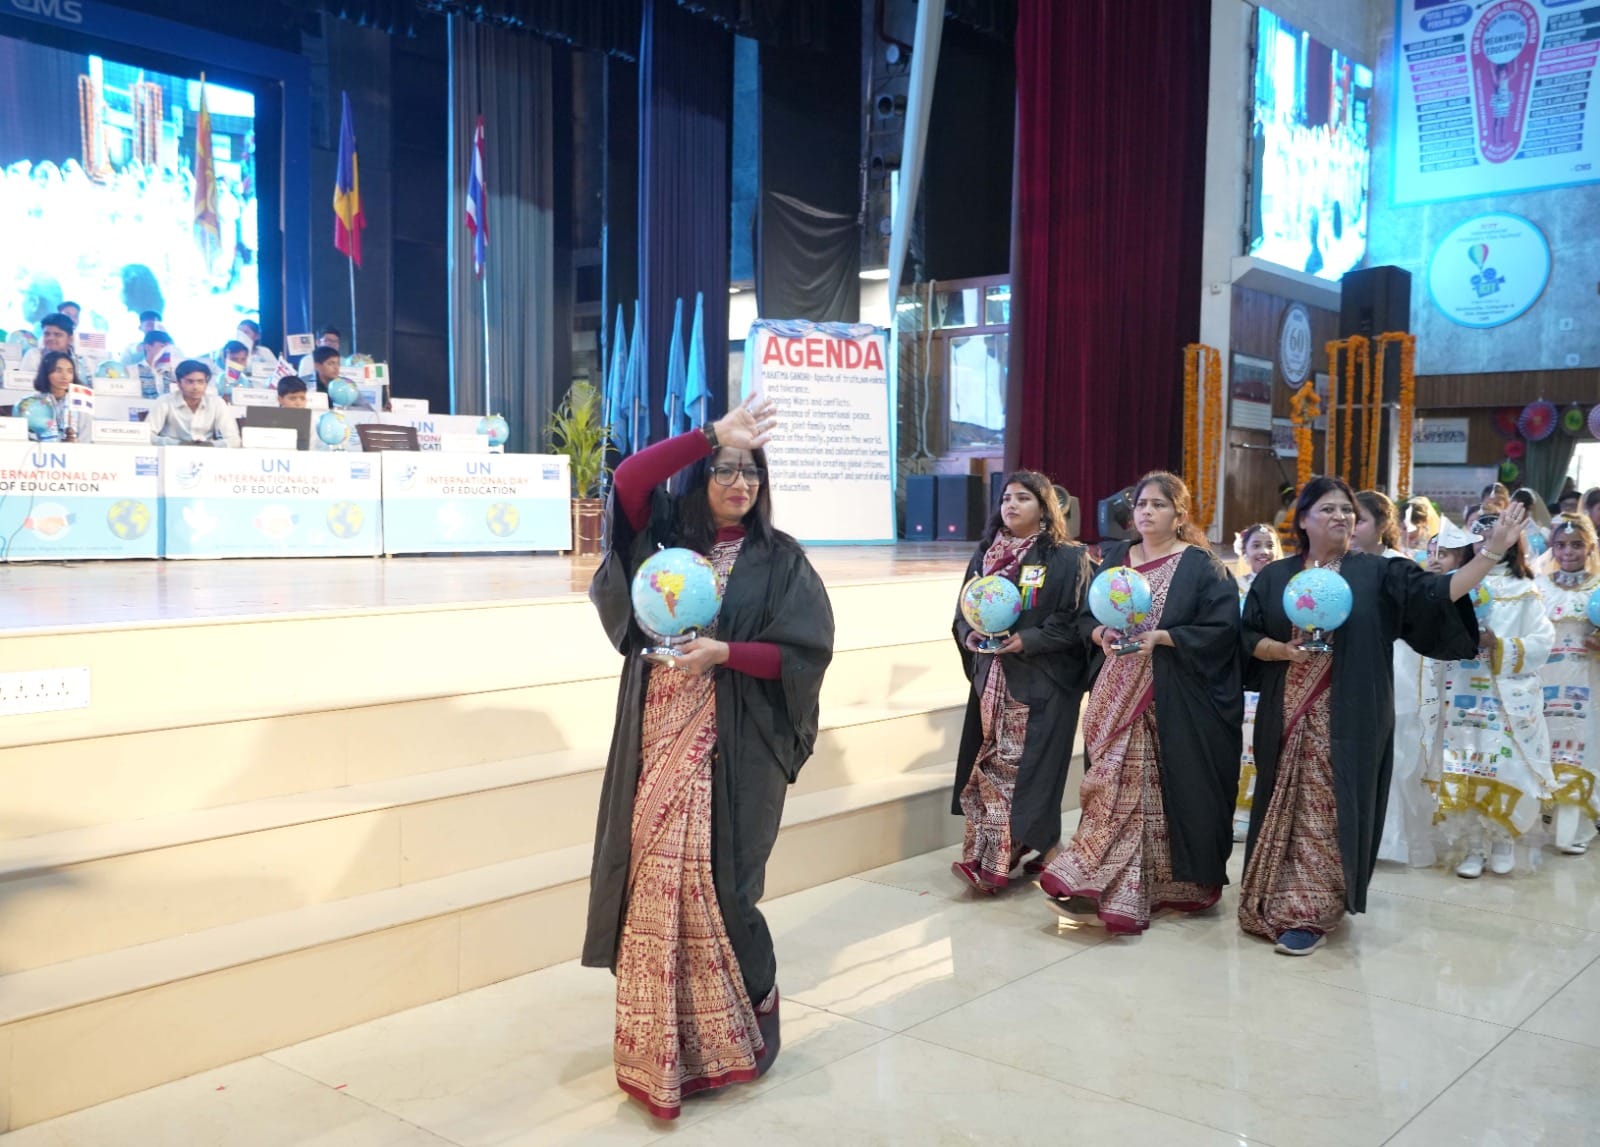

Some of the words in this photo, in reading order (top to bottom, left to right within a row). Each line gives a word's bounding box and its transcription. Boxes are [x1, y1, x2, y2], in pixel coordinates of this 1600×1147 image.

[1484, 32, 1525, 44] MEANINGFUL
[1486, 42, 1522, 56] EDUCATION
[762, 336, 884, 370] AGENDA
[811, 398, 821, 406] and
[804, 409, 810, 417] of
[812, 410, 850, 419] international
[852, 412, 872, 422] peace.
[807, 422, 826, 432] family
[863, 436, 882, 444] world.
[768, 446, 784, 456] Open
[785, 446, 824, 454] communication
[32, 453, 66, 468] UN
[262, 459, 290, 473] UN
[466, 462, 492, 475] UN
[91, 472, 118, 481] DAY
[214, 474, 308, 484] INTERNATIONAL
[312, 476, 335, 485] DAY
[426, 476, 508, 485] INTERNATIONAL
[510, 477, 529, 485] DAY
[0, 482, 15, 491] OF
[20, 482, 100, 492] EDUCATION
[232, 485, 248, 494] OF
[251, 485, 320, 495] EDUCATION
[442, 486, 455, 494] OF
[458, 486, 517, 495] EDUCATION
